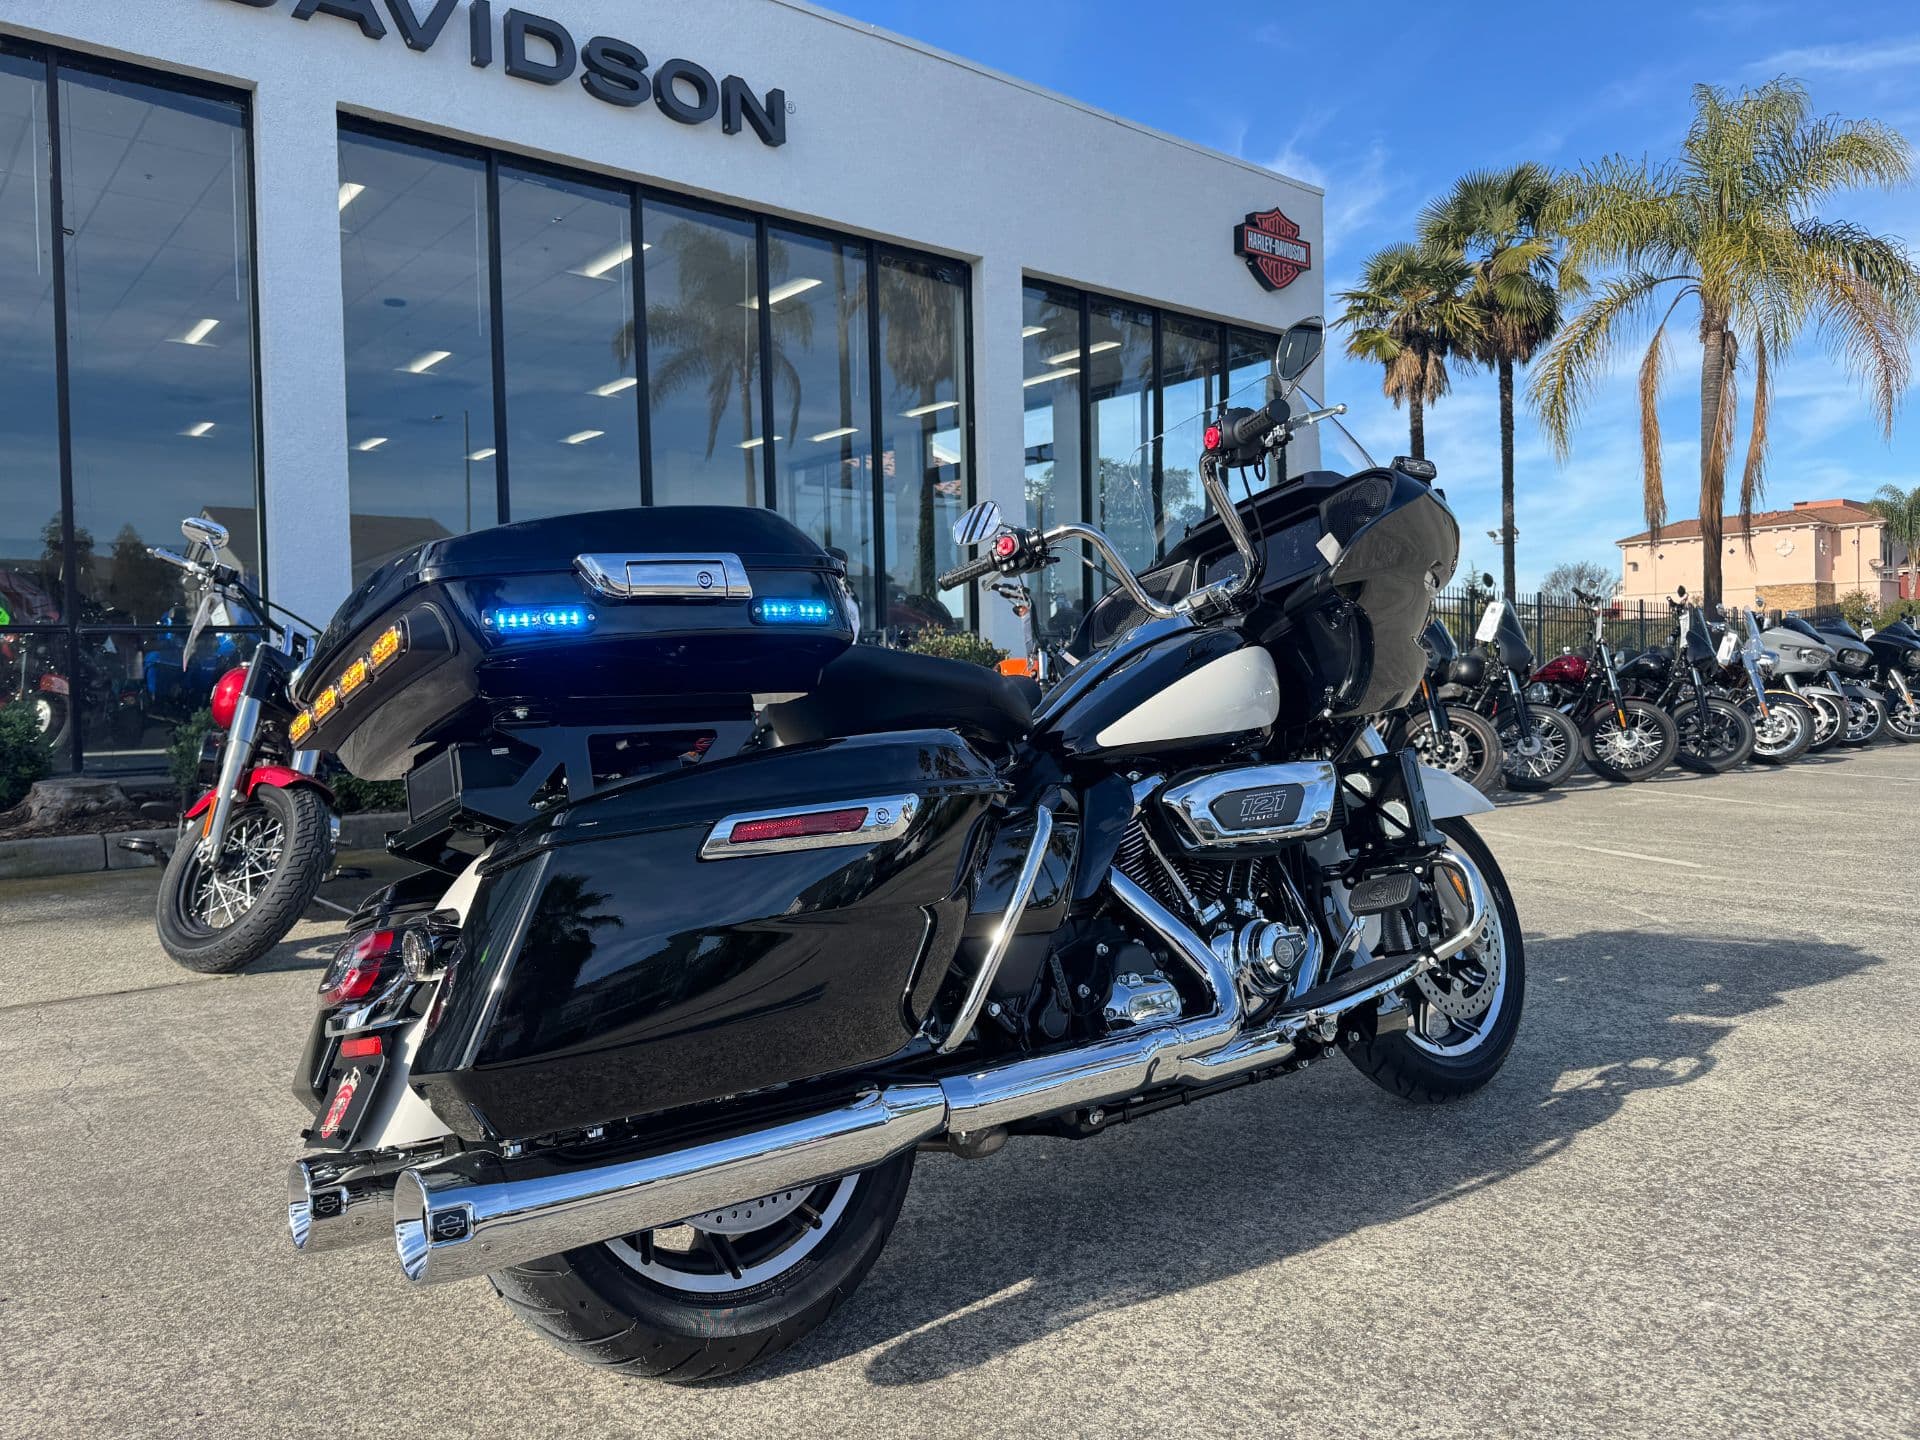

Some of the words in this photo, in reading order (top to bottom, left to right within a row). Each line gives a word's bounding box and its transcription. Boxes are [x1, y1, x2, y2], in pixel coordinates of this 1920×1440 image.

[1261, 217, 1293, 240] MOTOR
[1247, 231, 1306, 263] HARLEY-DAVIDSON
[1262, 257, 1293, 282] CYCLES
[1240, 793, 1286, 816] 121
[1241, 813, 1279, 822] POLICE
